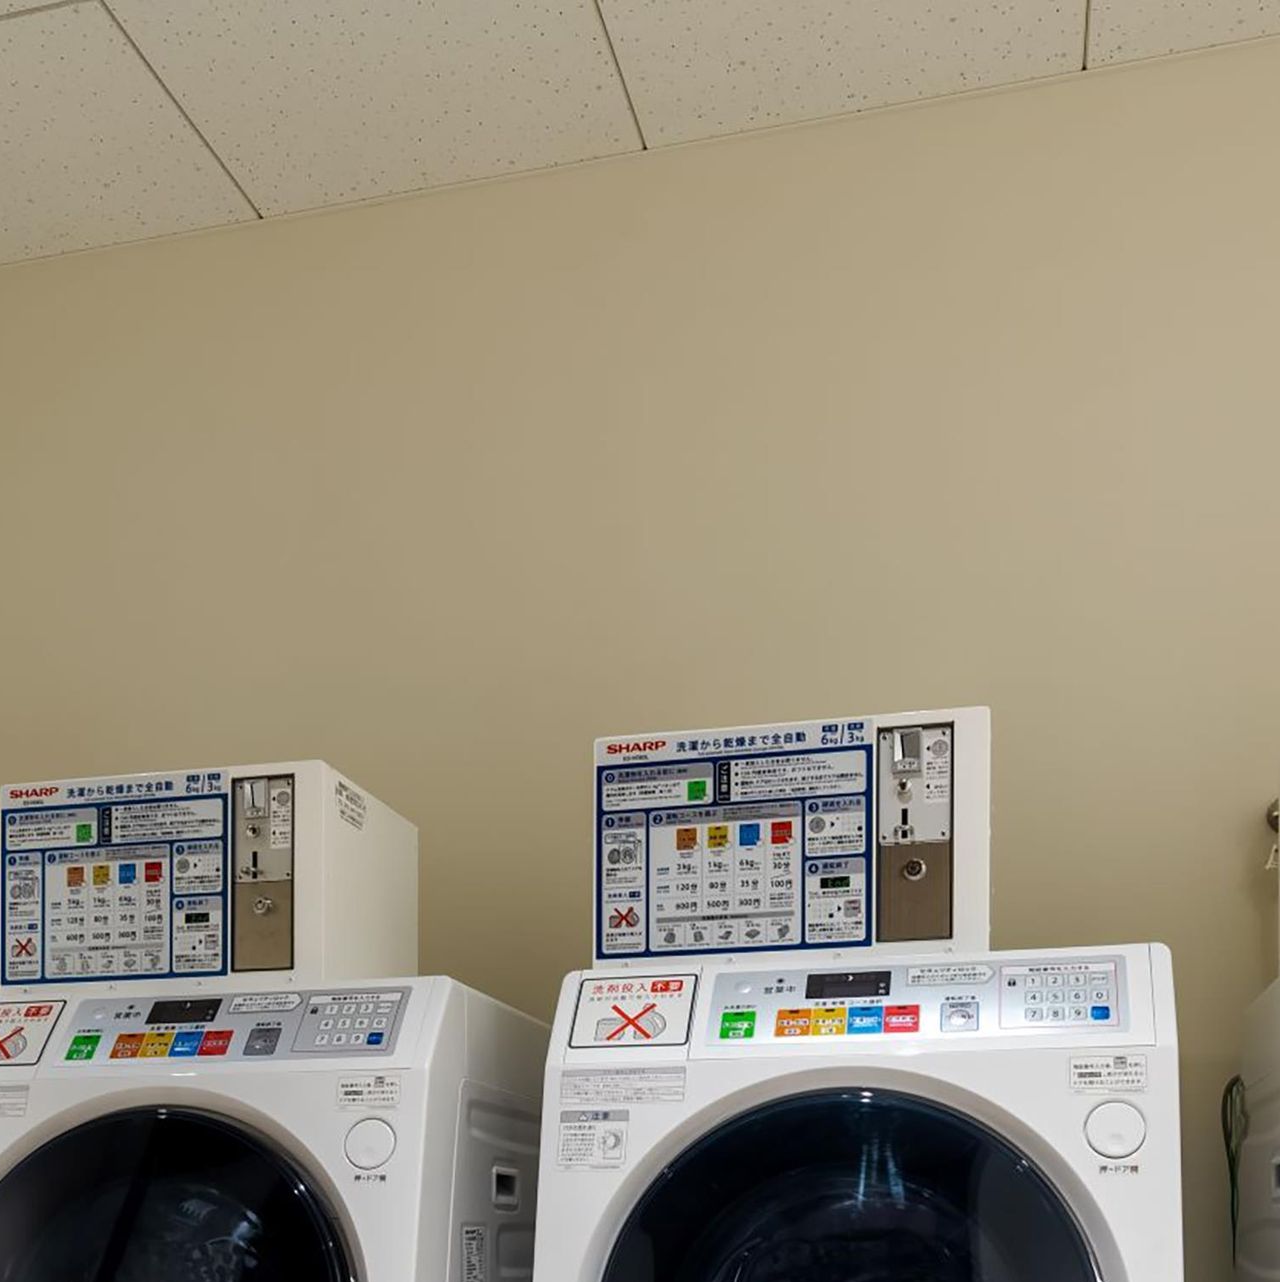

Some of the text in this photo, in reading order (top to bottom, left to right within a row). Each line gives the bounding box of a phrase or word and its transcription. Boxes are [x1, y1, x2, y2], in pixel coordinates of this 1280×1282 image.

[607, 740, 666, 754] SHARP
[676, 731, 807, 753] 洗濯から乾燥まで全自動
[9, 787, 59, 799] SHARP
